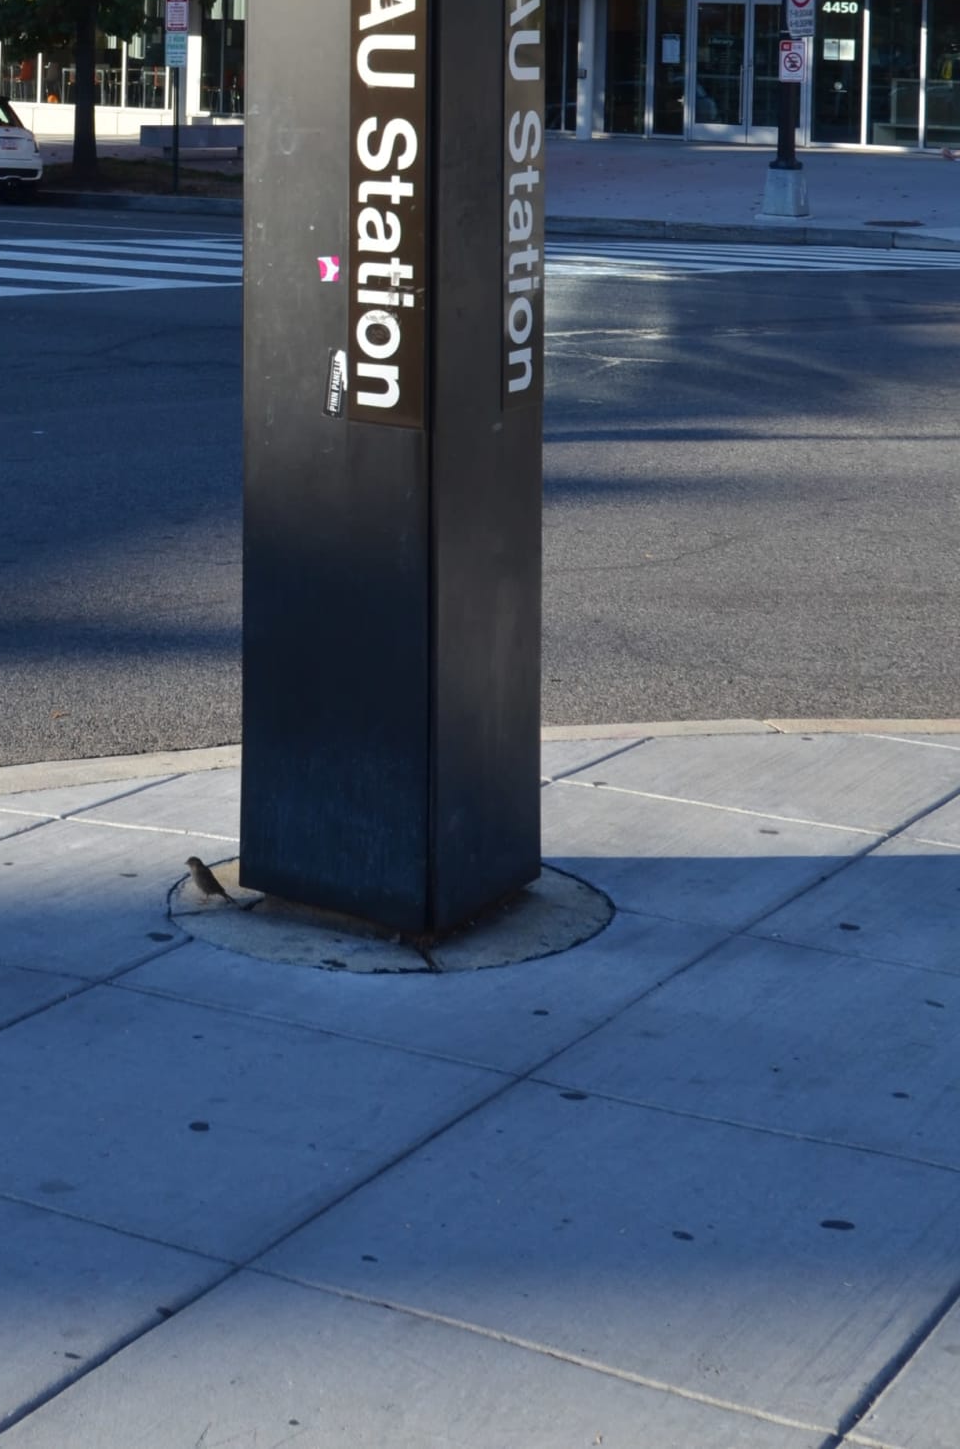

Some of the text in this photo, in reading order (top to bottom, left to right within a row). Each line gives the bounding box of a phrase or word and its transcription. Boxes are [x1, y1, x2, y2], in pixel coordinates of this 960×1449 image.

[822, 1, 858, 14] 4450
[356, 116, 419, 409] Station
[508, 109, 541, 393] Station
